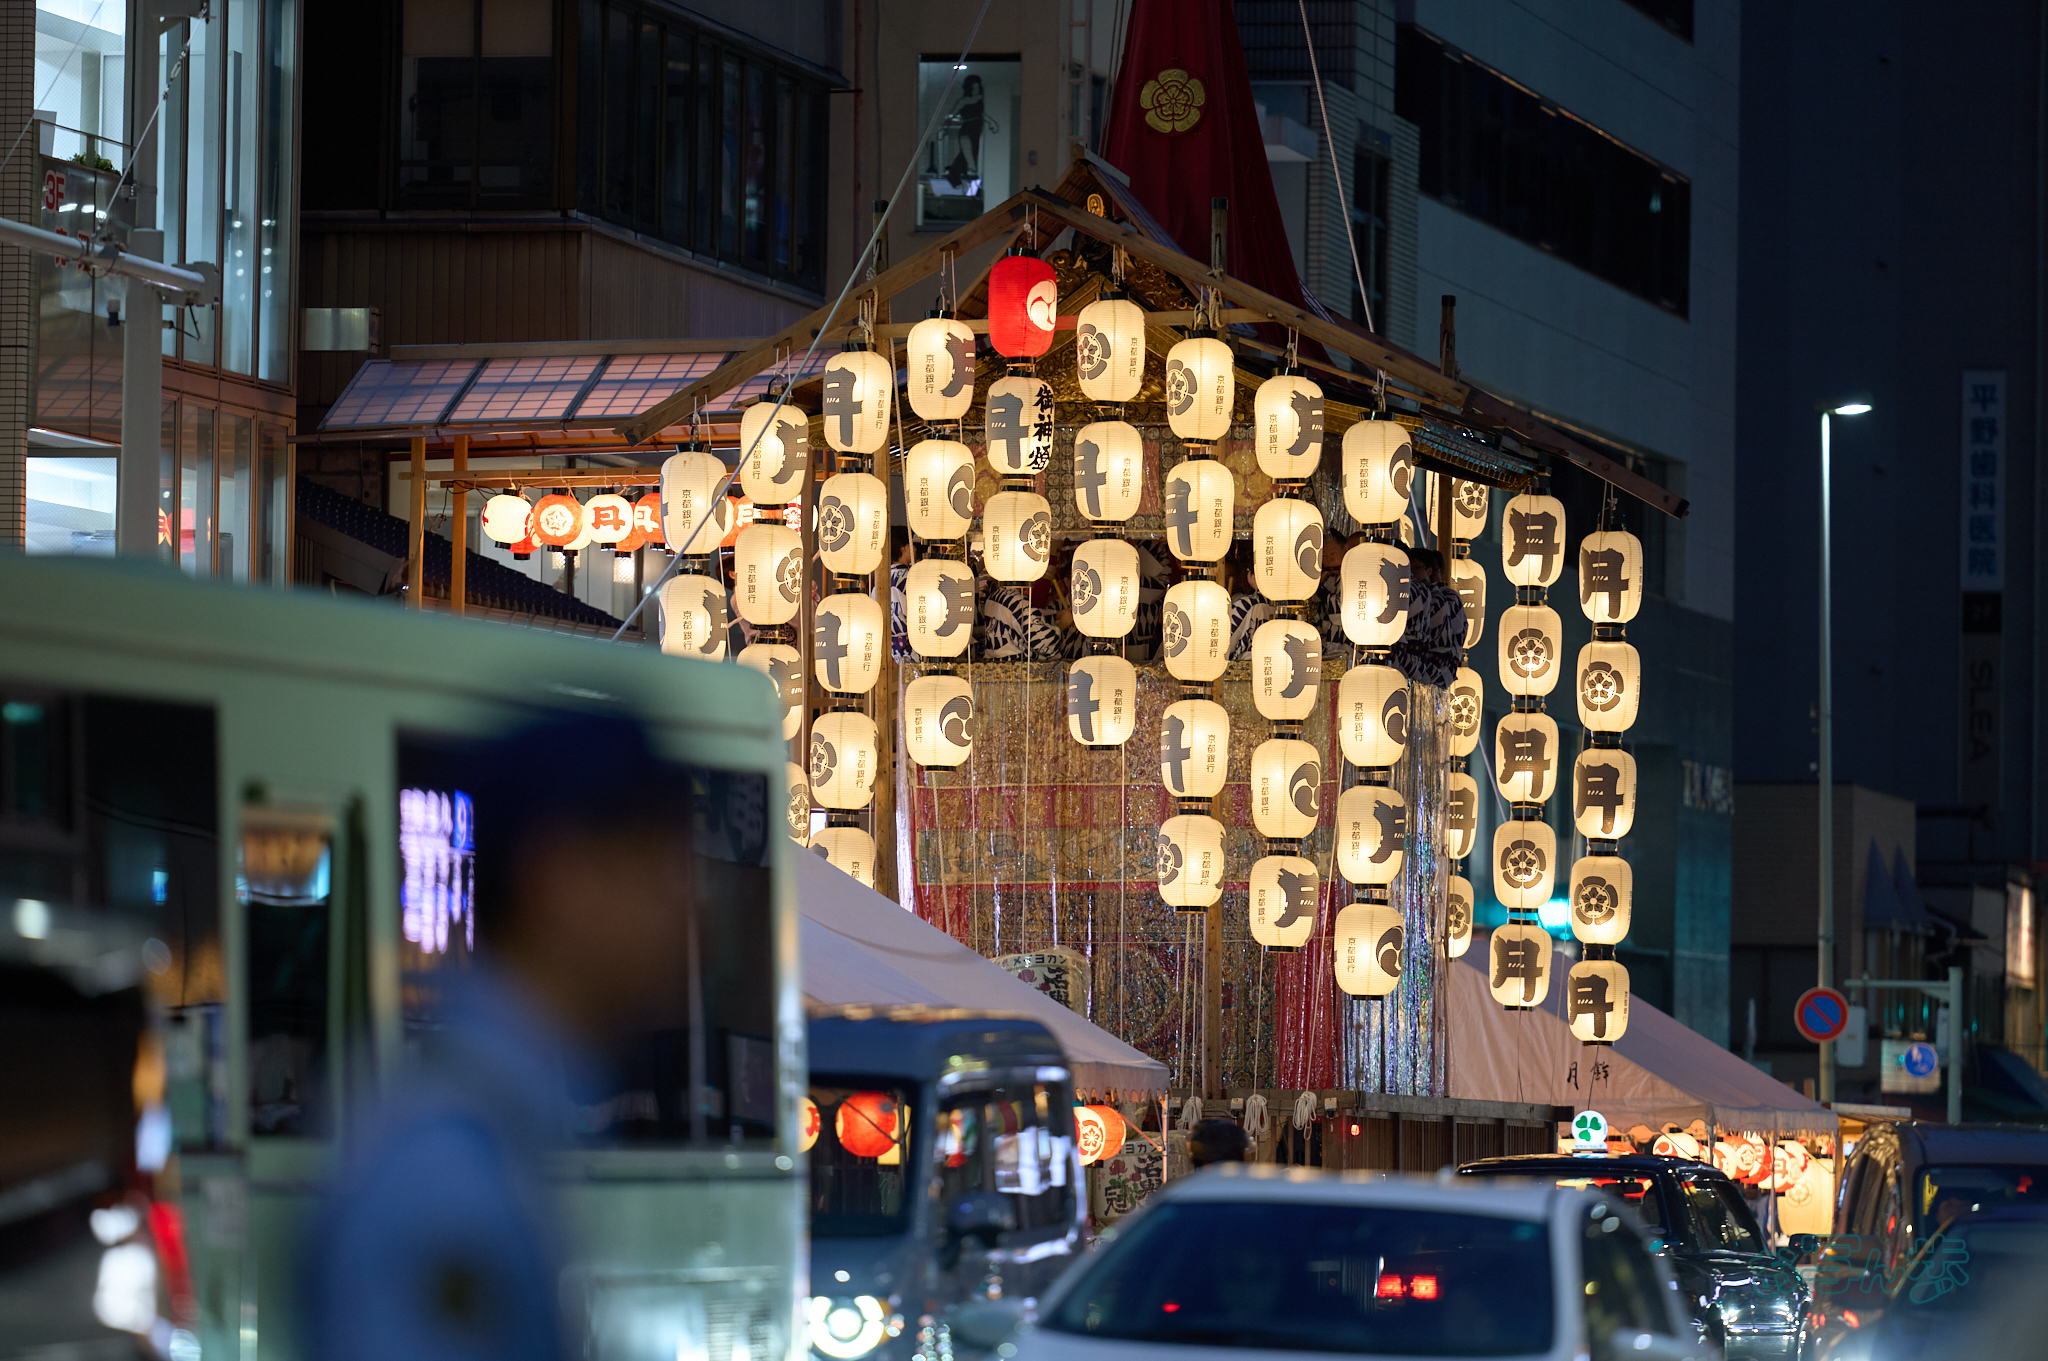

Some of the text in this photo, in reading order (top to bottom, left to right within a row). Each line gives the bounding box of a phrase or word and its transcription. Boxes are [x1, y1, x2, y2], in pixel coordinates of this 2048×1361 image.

[46, 174, 65, 212] 3F
[925, 354, 935, 393] 京都銀行
[1129, 337, 1138, 377] 京都銀行
[876, 389, 885, 429] 京都銀行
[1215, 375, 1225, 415] 京都銀行
[1269, 413, 1278, 454] 京都銀行
[752, 439, 762, 479] 京都銀行
[1121, 458, 1131, 497] 京都銀行
[1359, 458, 1369, 498] 京都銀行
[920, 477, 929, 517] 京都銀行
[1968, 383, 1998, 576] 平野歯科医院
[682, 489, 692, 529] 京都銀行
[1213, 498, 1223, 538] 京都銀行
[870, 510, 881, 550] 京都銀行
[992, 526, 1000, 561] 京都銀行
[1265, 536, 1274, 576] 京都銀行
[747, 564, 757, 604] 京都銀行
[1118, 576, 1129, 615] 京都銀行
[1358, 580, 1367, 620] 京都銀行
[682, 610, 692, 650] 京都銀行
[918, 595, 927, 634] 京都銀行
[863, 632, 873, 672] 京都銀行
[1210, 618, 1219, 658] 京都銀行
[1264, 656, 1272, 696] 京都銀行
[914, 707, 923, 743] 京都銀行
[1113, 689, 1123, 725] 京都銀行
[1354, 702, 1363, 742] 京都銀行
[856, 750, 867, 789] 京都銀行
[1206, 734, 1216, 773] 京都銀行
[1261, 777, 1269, 816] 京都銀行
[1352, 821, 1360, 860] 京都銀行
[1201, 851, 1211, 886] 京都銀行
[1347, 937, 1356, 973] 京都銀行
